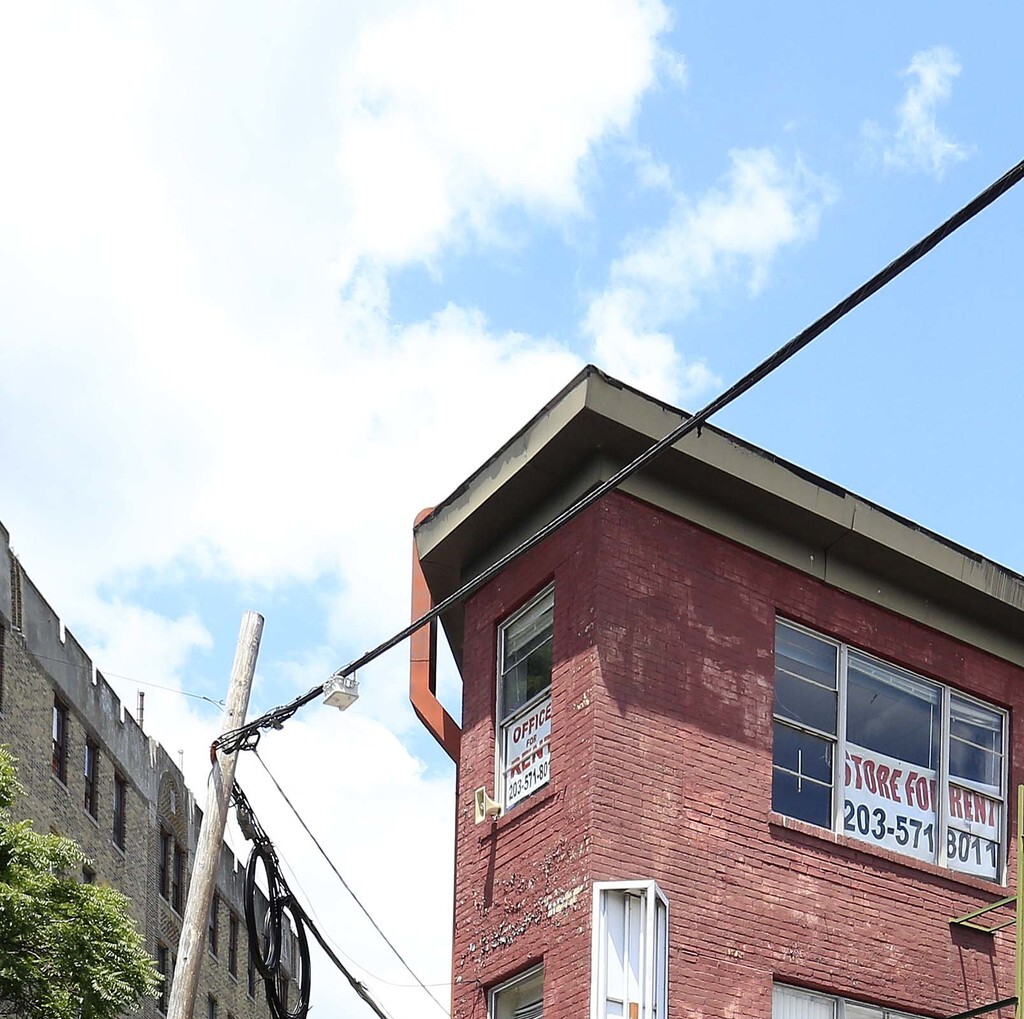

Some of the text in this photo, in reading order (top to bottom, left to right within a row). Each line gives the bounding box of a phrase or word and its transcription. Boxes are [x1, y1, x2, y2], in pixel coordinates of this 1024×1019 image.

[513, 702, 552, 743] OFFICE
[526, 734, 537, 748] FOR
[510, 735, 551, 778] RENT
[508, 762, 551, 800] 203-571-80
[845, 750, 902, 803] STORE
[949, 786, 995, 827] RENT
